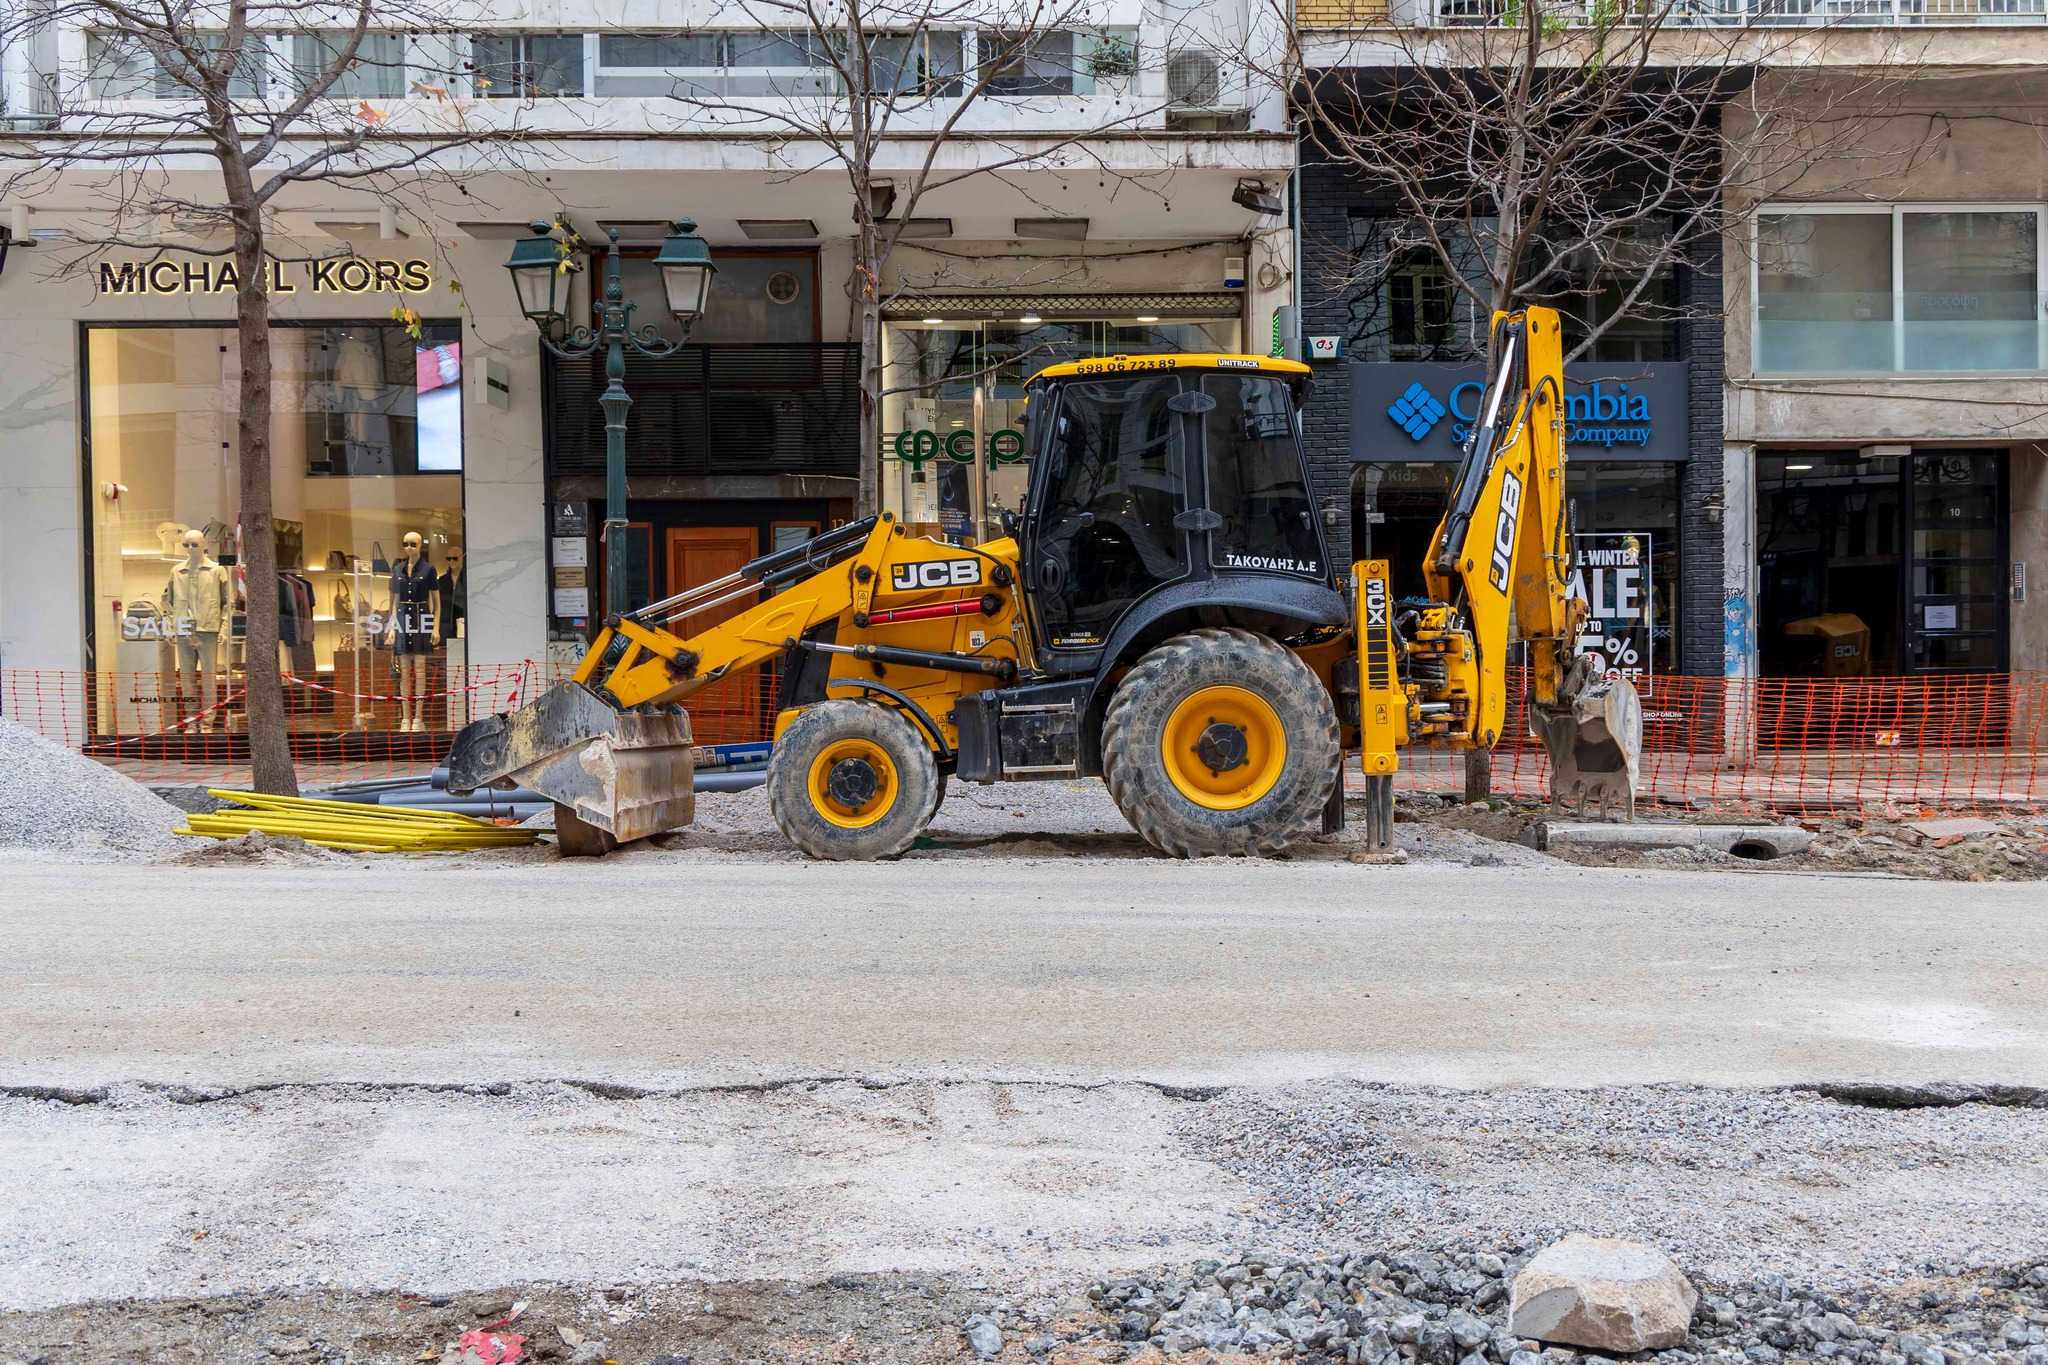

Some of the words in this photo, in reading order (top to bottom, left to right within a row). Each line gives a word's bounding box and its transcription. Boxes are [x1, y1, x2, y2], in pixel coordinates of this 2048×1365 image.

[312, 259, 430, 293] KORS
[1077, 364, 1104, 374] 698
[1107, 362, 1125, 372] 06
[1159, 359, 1176, 369] 89
[1217, 359, 1259, 368] UNITRACK
[1450, 381, 1652, 421] Cmbia
[1565, 423, 1651, 447] Company
[1388, 470, 1418, 482] Kids
[1950, 508, 1961, 517] 10
[1493, 473, 1520, 591] JCB
[1226, 554, 1294, 571] ΤΑΚΟΥΔΗΣ
[1588, 550, 1639, 566] WINTER
[894, 559, 980, 589] JCB
[1367, 579, 1386, 625] 3CX
[1565, 568, 1640, 618] ALE
[123, 616, 193, 636] SALE
[366, 613, 435, 634] SALE
[1576, 620, 1589, 632] UP
[1589, 620, 1602, 632] TO
